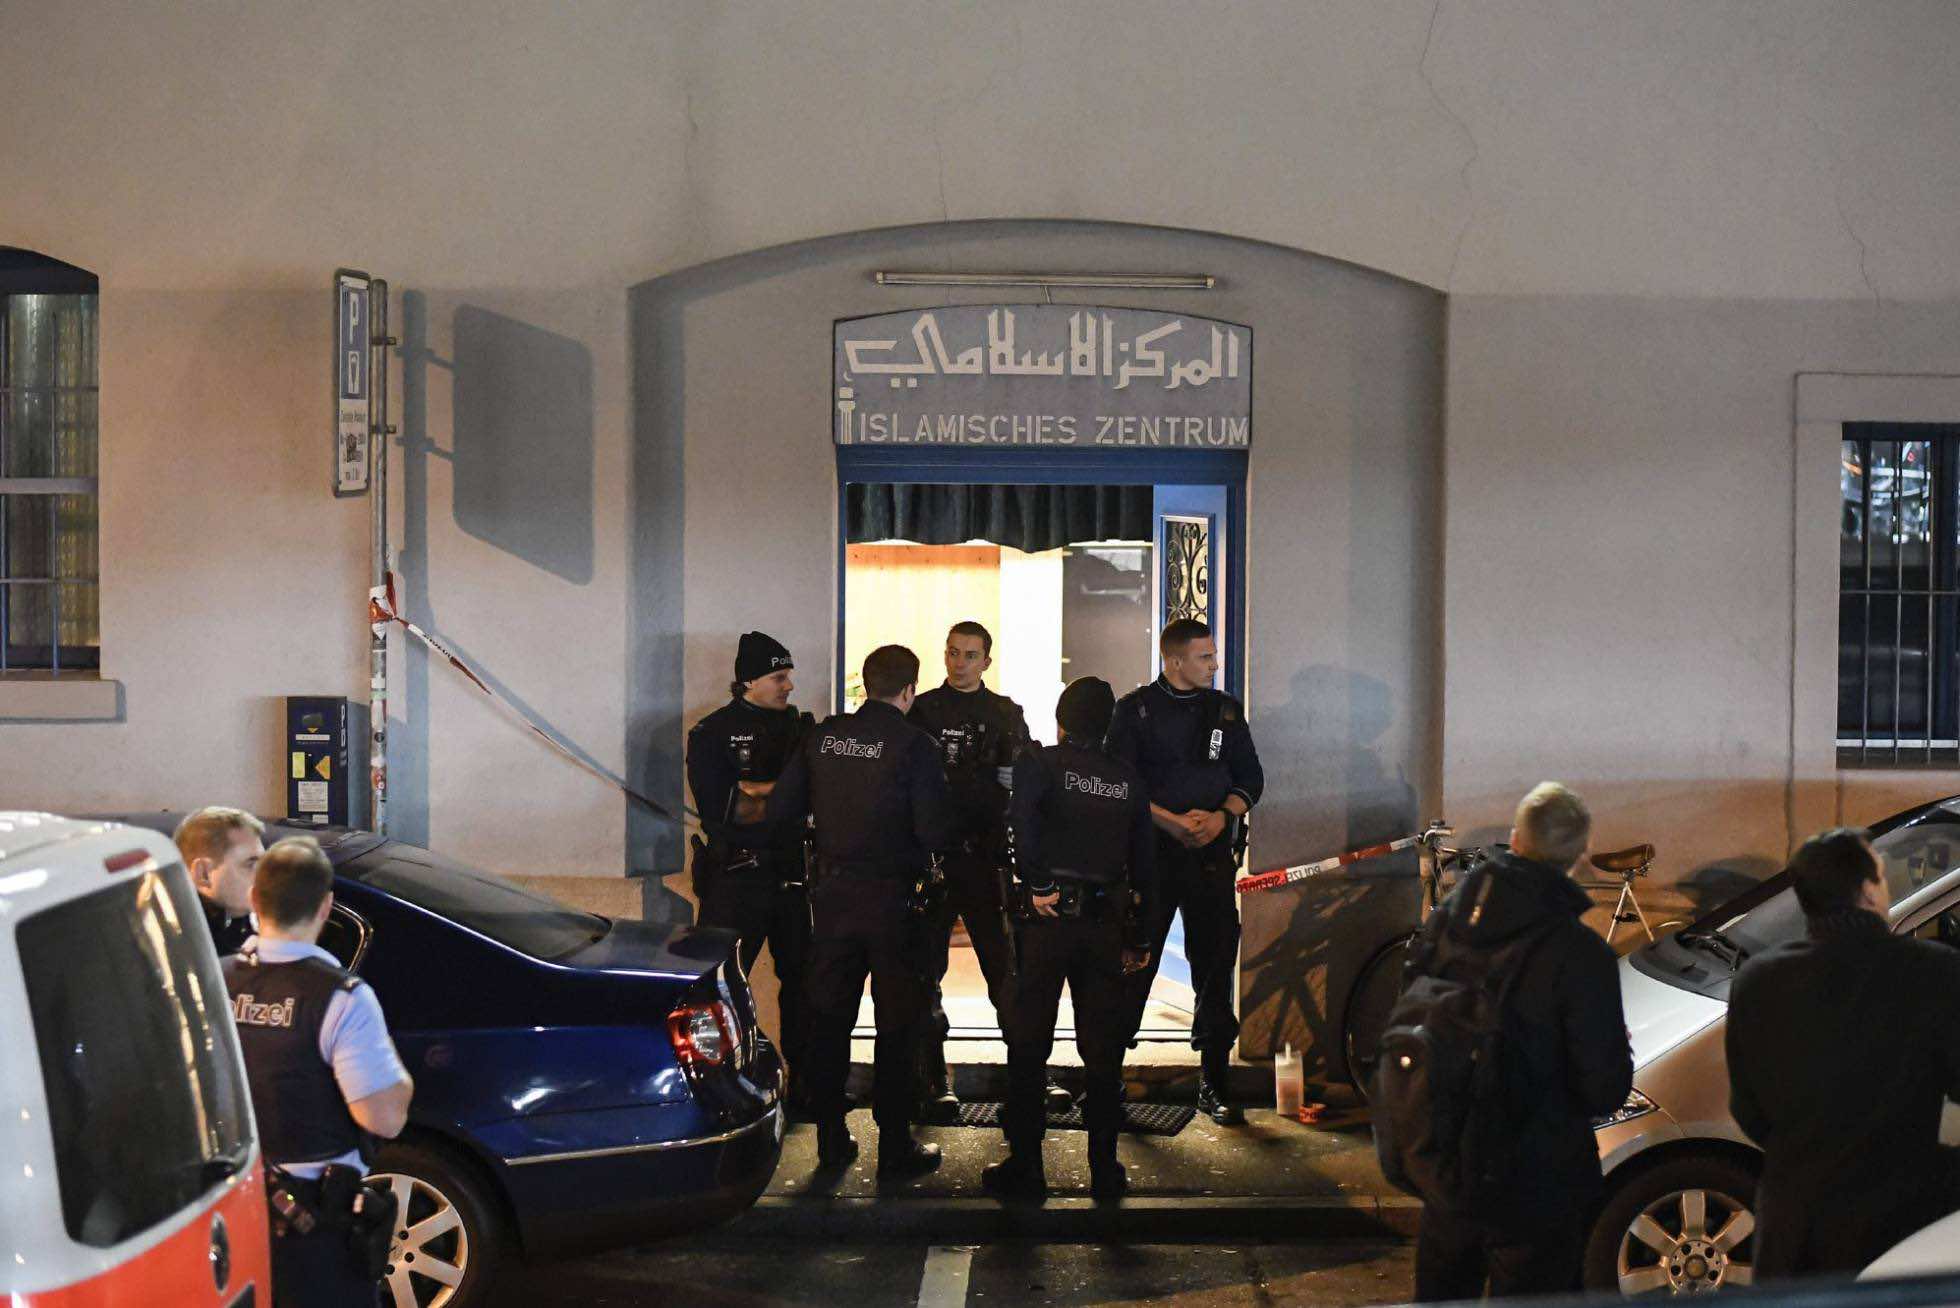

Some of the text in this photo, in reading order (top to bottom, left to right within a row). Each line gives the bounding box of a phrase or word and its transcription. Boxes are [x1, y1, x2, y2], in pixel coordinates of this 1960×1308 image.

[1112, 319, 1240, 390] المركز
[860, 413, 1249, 447] ISLAMISCHES ZENTRUM
[821, 736, 884, 759] Polizei
[1064, 771, 1129, 800] Polizei
